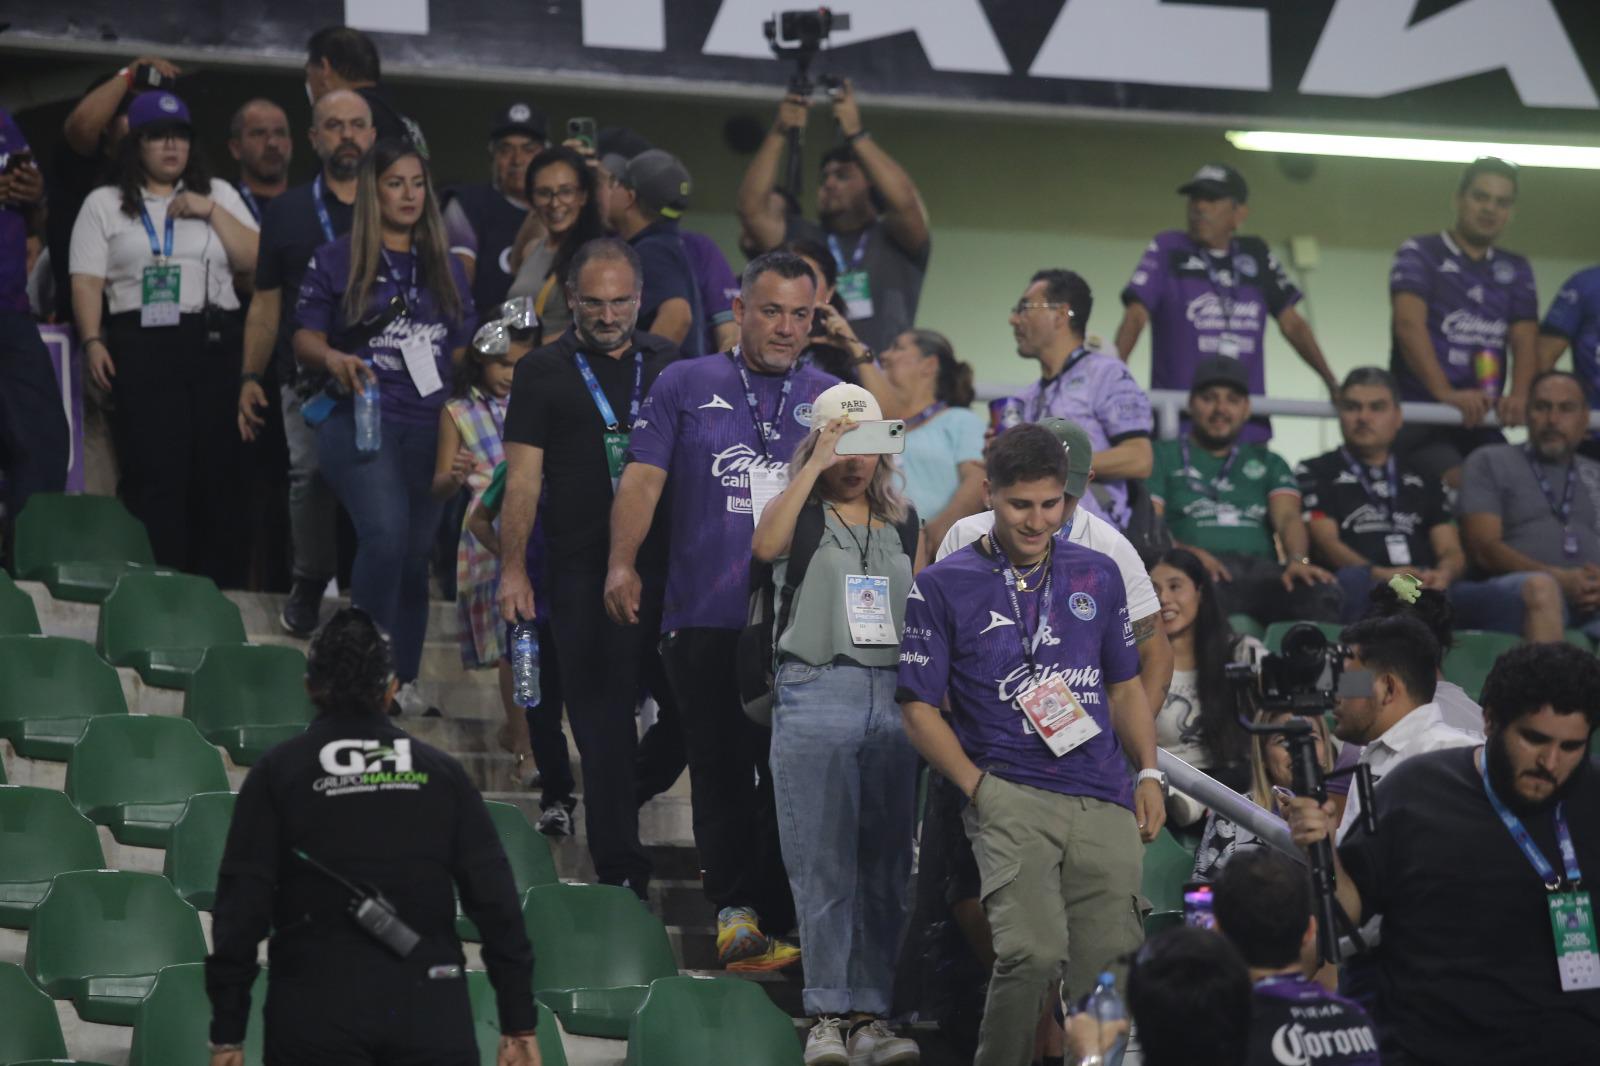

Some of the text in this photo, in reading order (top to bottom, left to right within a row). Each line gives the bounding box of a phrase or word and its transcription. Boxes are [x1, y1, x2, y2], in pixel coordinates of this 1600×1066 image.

[841, 400, 867, 409] PARIS
[848, 577, 862, 585] AP
[900, 651, 930, 666] alplay
[319, 738, 412, 776] GH
